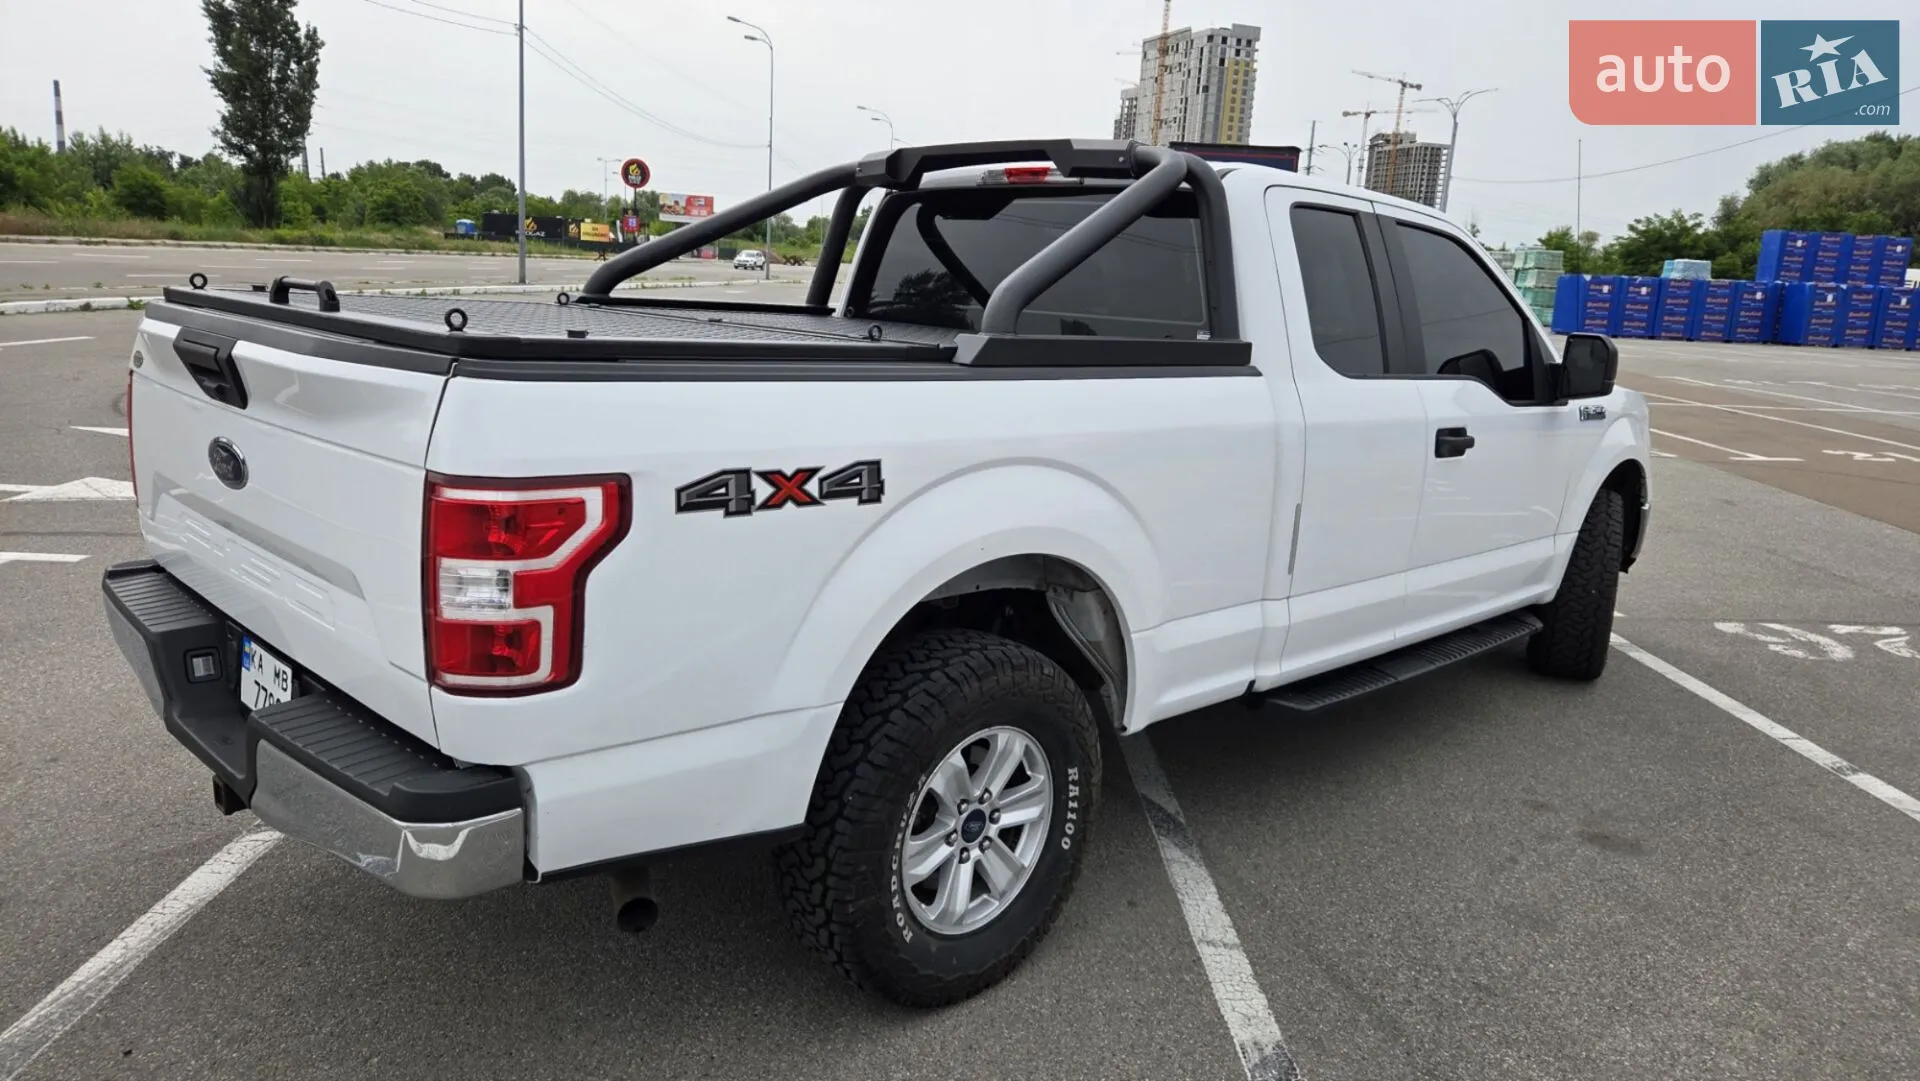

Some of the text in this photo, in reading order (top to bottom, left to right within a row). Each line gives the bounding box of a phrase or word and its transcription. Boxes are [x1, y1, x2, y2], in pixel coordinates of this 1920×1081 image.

[251, 649, 289, 692] KA MB
[254, 679, 282, 708] 77
